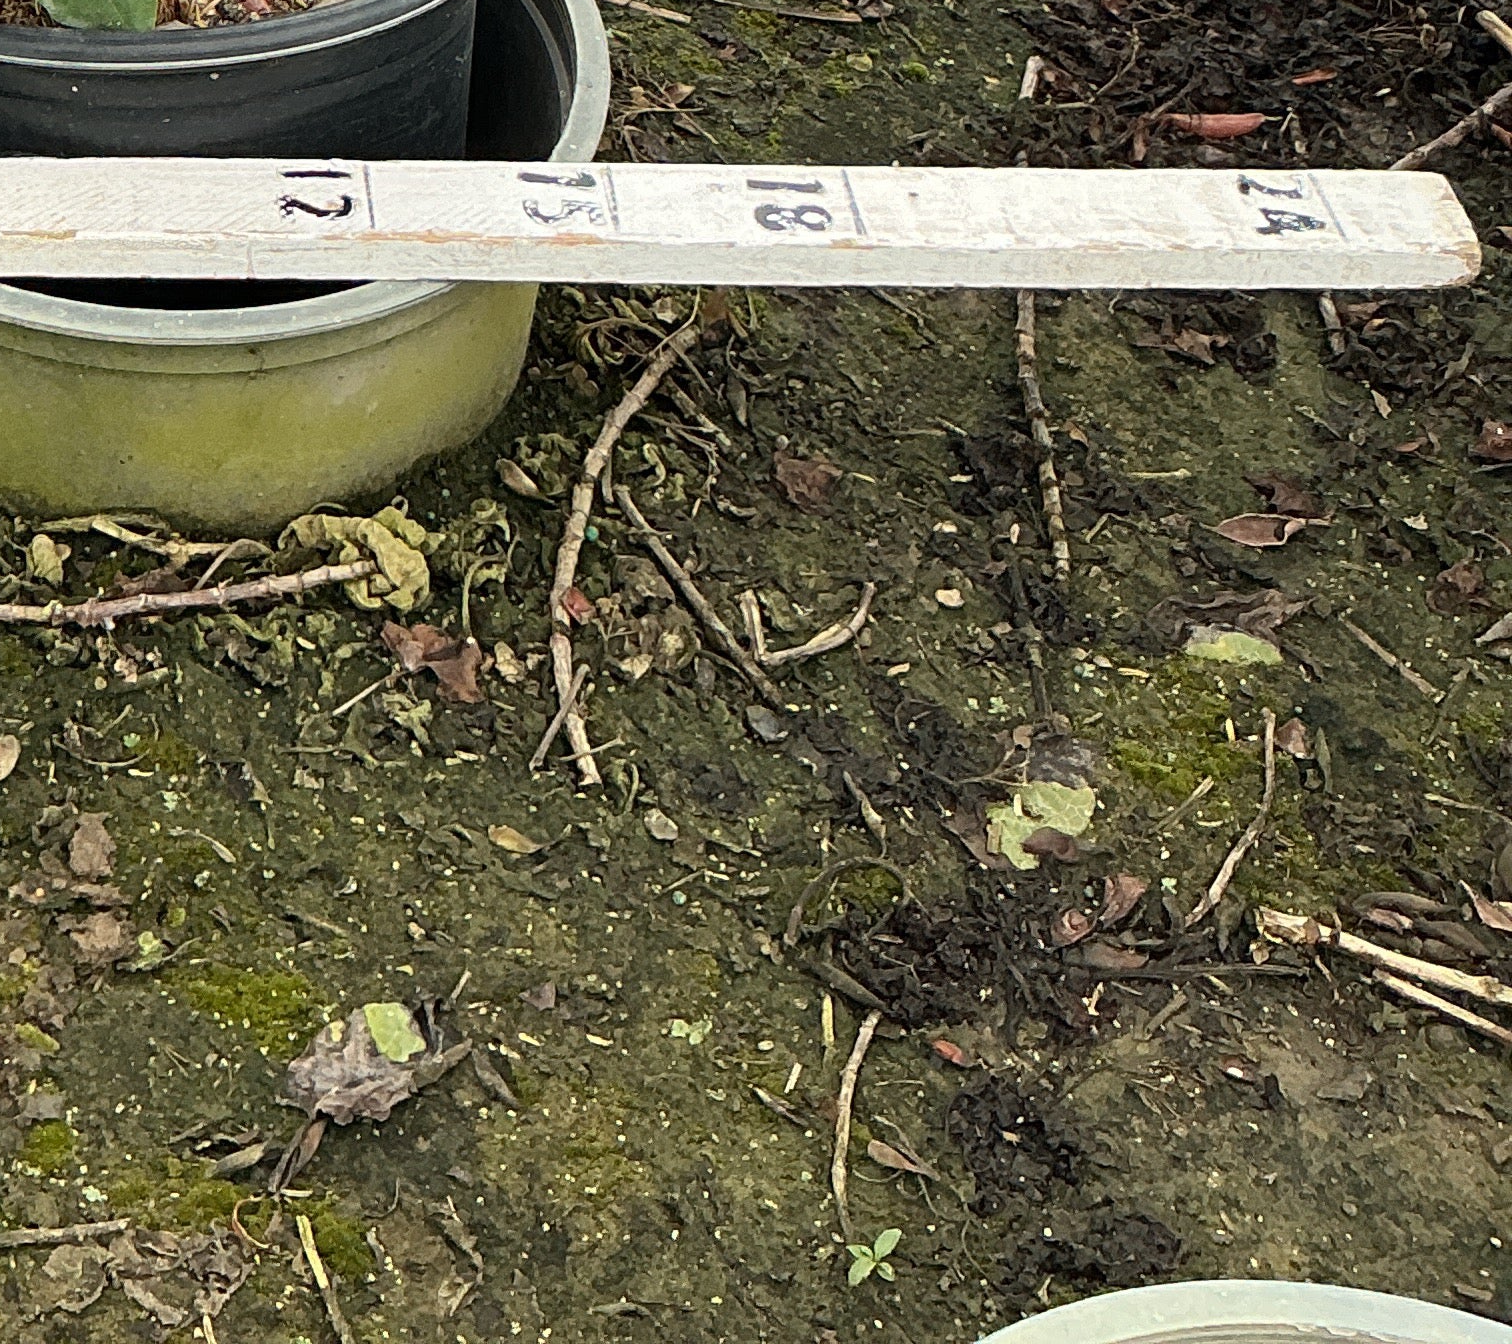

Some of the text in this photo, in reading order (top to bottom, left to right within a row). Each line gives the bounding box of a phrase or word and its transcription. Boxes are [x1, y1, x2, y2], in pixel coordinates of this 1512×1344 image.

[274, 169, 354, 220] 12
[516, 169, 607, 226] 15
[745, 178, 833, 231] 18
[1235, 172, 1327, 236] 24
